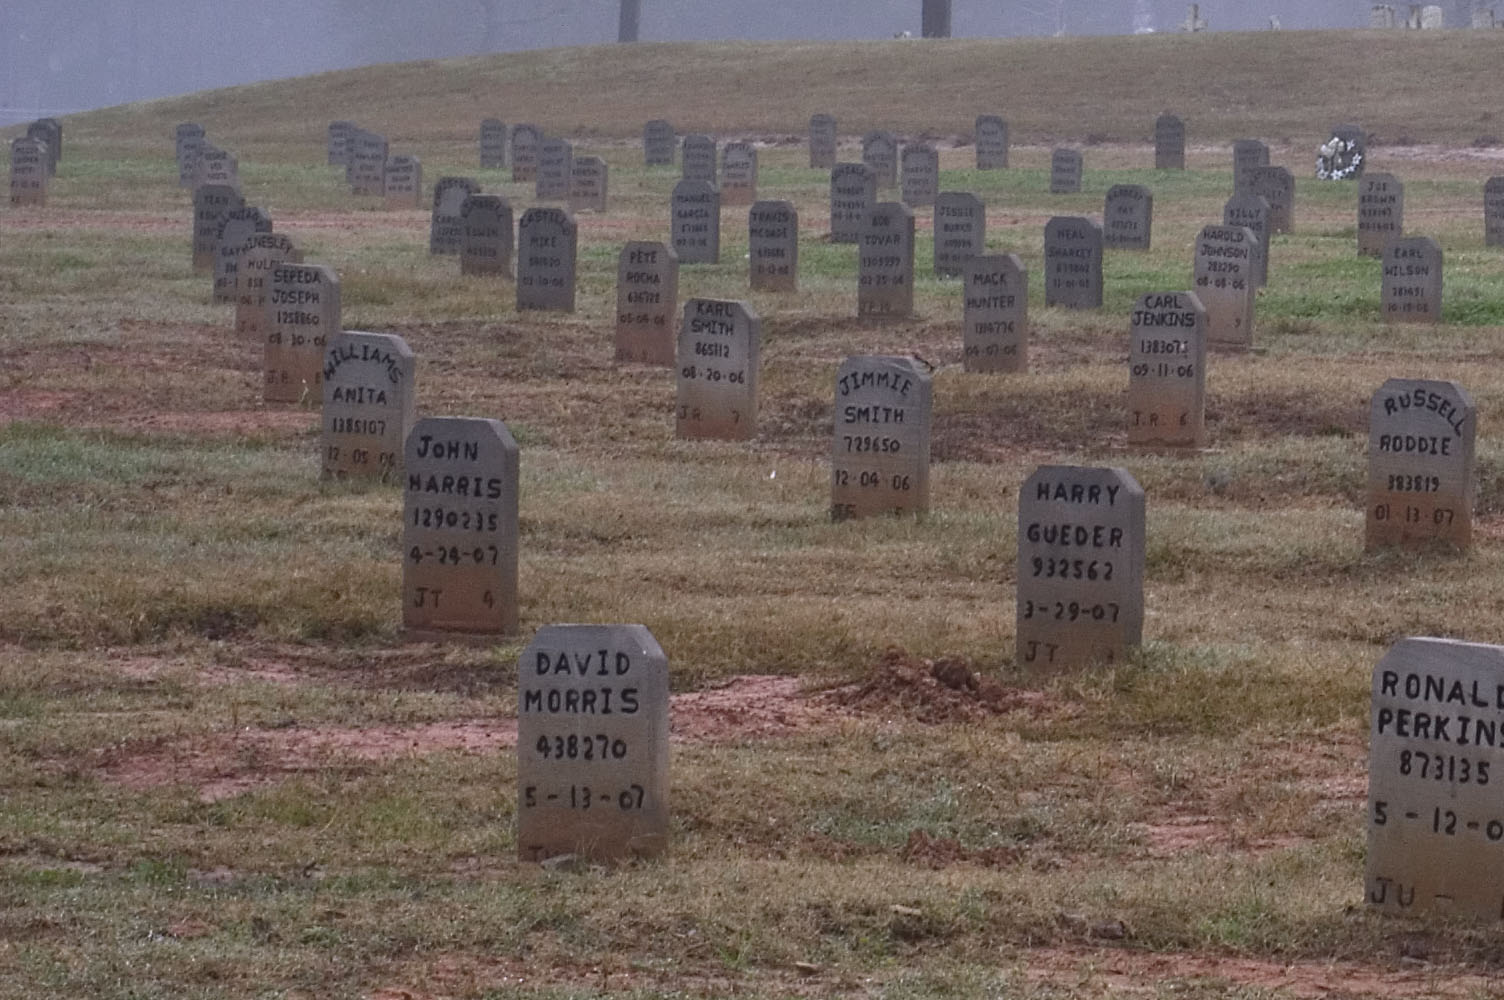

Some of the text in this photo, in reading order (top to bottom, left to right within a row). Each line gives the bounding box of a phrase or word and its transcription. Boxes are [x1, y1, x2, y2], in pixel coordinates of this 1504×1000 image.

[752, 211, 789, 224] TRAVIS
[939, 206, 974, 219] JESSIE
[530, 236, 557, 249] MIKE
[864, 234, 901, 246] TOVAR
[1057, 229, 1086, 241] NEAL
[1202, 229, 1245, 243] HAROLD
[629, 250, 657, 265] PETE
[1047, 247, 1093, 259] SHARKEY
[1200, 244, 1248, 260] JOHNSON
[273, 269, 322, 284] SEPEDA
[625, 271, 661, 286] ROCHA
[973, 273, 1008, 286] MACK
[1384, 265, 1430, 277] WILSON
[272, 289, 320, 305] JOSEPH
[966, 295, 1016, 310] HUNTER
[1144, 295, 1183, 310] CARL
[696, 302, 734, 318] KARL
[690, 320, 734, 337] SMITH
[1132, 311, 1196, 328] JENKINS
[695, 342, 730, 359] 865112
[322, 344, 403, 385] WILLIAMS
[838, 371, 914, 398] JIMMIE
[332, 386, 387, 406] ANITA
[844, 406, 905, 424] SMITH
[1384, 388, 1465, 437] RUSSELL
[332, 416, 386, 436] 1385107
[417, 434, 479, 461] JOHN
[843, 436, 901, 454] 729650
[1380, 434, 1452, 456] RODDIE
[409, 472, 502, 500] HARRIS
[1388, 473, 1440, 493] 383819
[1035, 482, 1121, 506] HARRY
[413, 507, 498, 532] 1290235
[1026, 523, 1125, 548] GUEDER
[1031, 557, 1113, 581] 932562
[413, 586, 443, 609] JT
[1024, 640, 1059, 663] JT
[535, 650, 631, 676] DAVID
[525, 689, 639, 714] MORRIS
[536, 735, 627, 760] 438270
[1400, 751, 1490, 785] 873135
